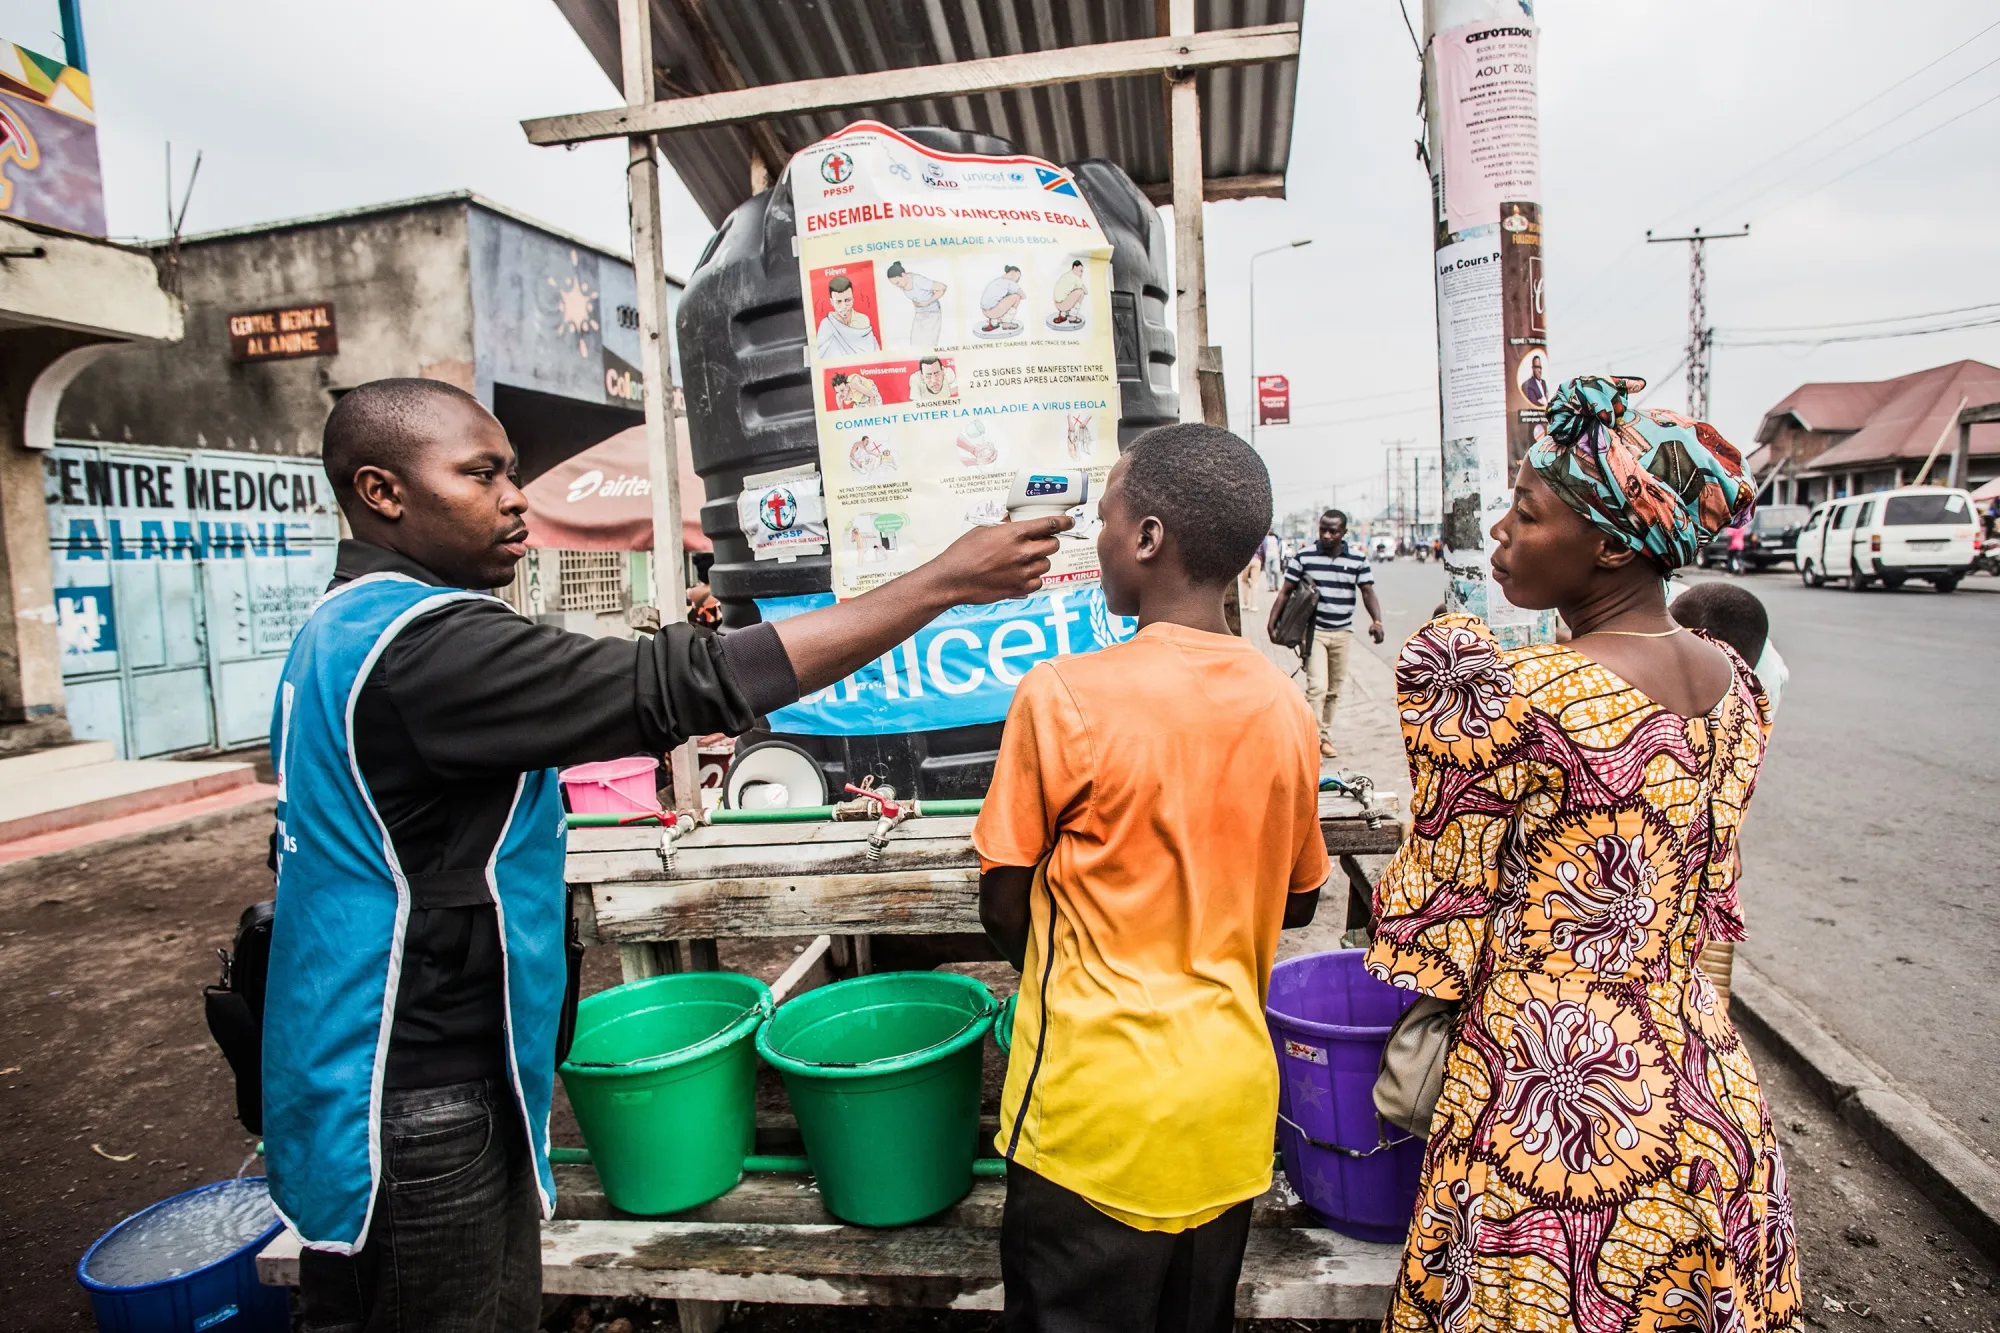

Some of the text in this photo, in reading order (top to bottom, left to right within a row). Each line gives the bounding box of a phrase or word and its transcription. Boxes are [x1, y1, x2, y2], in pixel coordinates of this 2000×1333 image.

[1475, 64, 1509, 78] AOUT
[921, 173, 959, 189] USAID
[962, 171, 1006, 182] unicef
[823, 185, 855, 198] PPSSP
[807, 202, 1091, 232] ENSEMBLE NOUS VAINCRONS EBOLA
[844, 236, 1059, 255] LES SIGNES DE LA MALADIE A VIRUS EBOLA
[824, 267, 847, 277] Fièvre
[1439, 263, 1454, 275] Les
[1457, 256, 1489, 269] Cours
[860, 366, 907, 376] Vomissement
[973, 364, 1103, 378] CES SIGNES SE MANIFESTENT ENTRE
[970, 381, 974, 389] 2
[983, 380, 992, 388] 21
[994, 377, 1022, 387] JOURS
[1023, 375, 1048, 384] APRES
[1049, 375, 1058, 383] LA
[1058, 374, 1109, 383] CONTAMINATION
[916, 399, 961, 408] SAIGNEMENT
[835, 400, 1107, 430] COMMENT EVITER LA MALADIE A VIRUS EBOLA
[972, 472, 1007, 481] FREQUEMMENT
[185, 467, 326, 513] MEDICAL
[64, 515, 314, 562] ALANINE
[767, 529, 803, 541] PPSSP
[1041, 576, 1062, 585] ADIE
[1072, 571, 1098, 581] VIRUS
